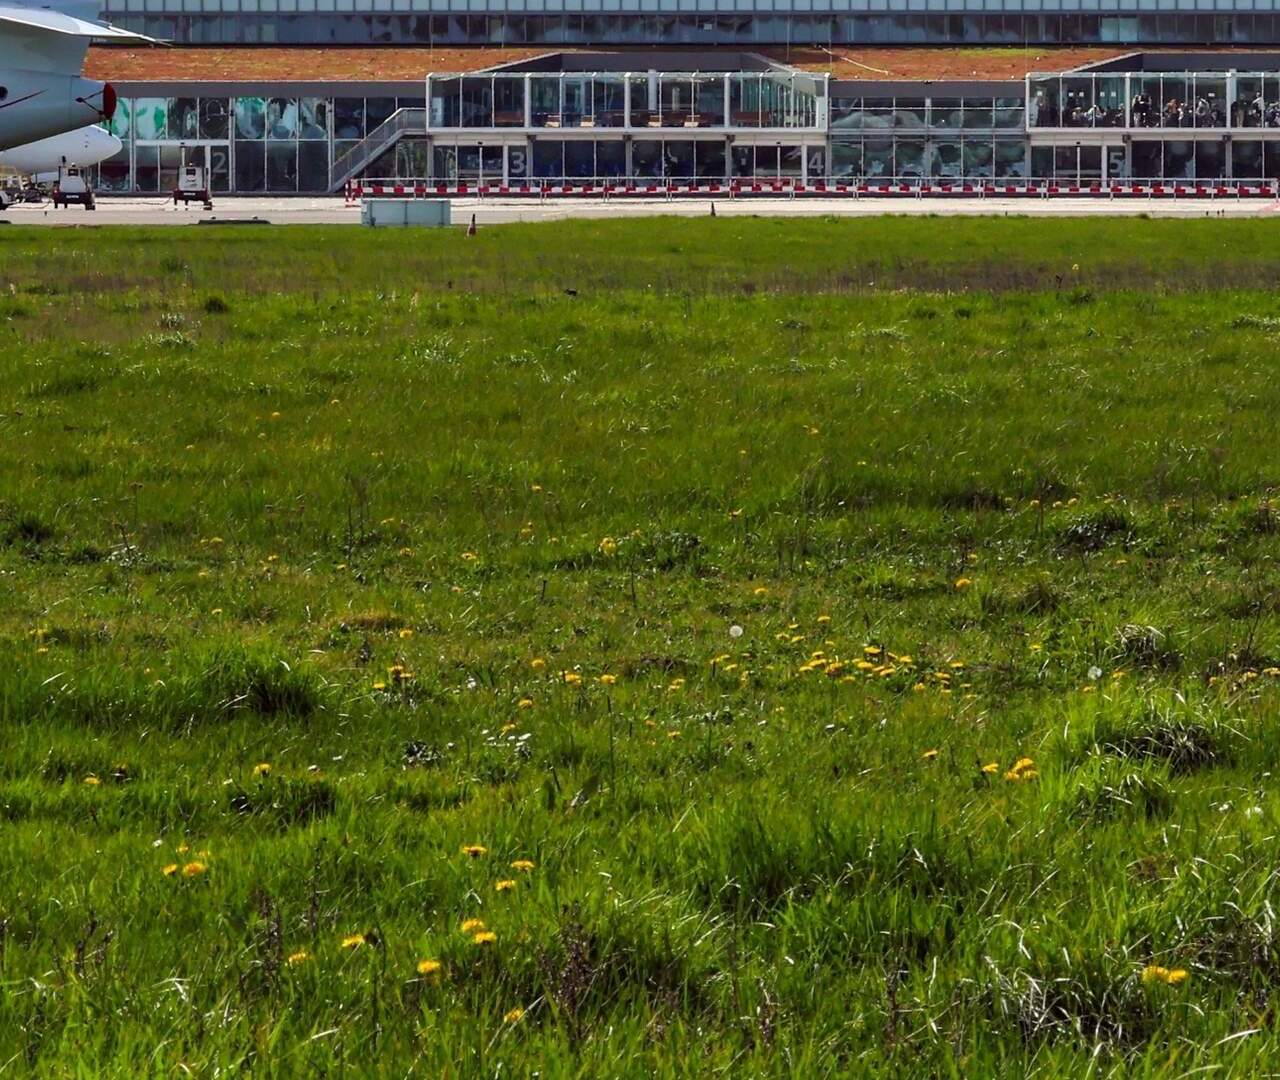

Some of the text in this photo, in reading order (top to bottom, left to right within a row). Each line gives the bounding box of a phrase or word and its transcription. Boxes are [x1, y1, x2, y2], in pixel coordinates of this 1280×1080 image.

[212, 152, 227, 173] 2
[511, 152, 525, 173] 3
[809, 152, 824, 173] 4
[1110, 152, 1124, 173] 5
